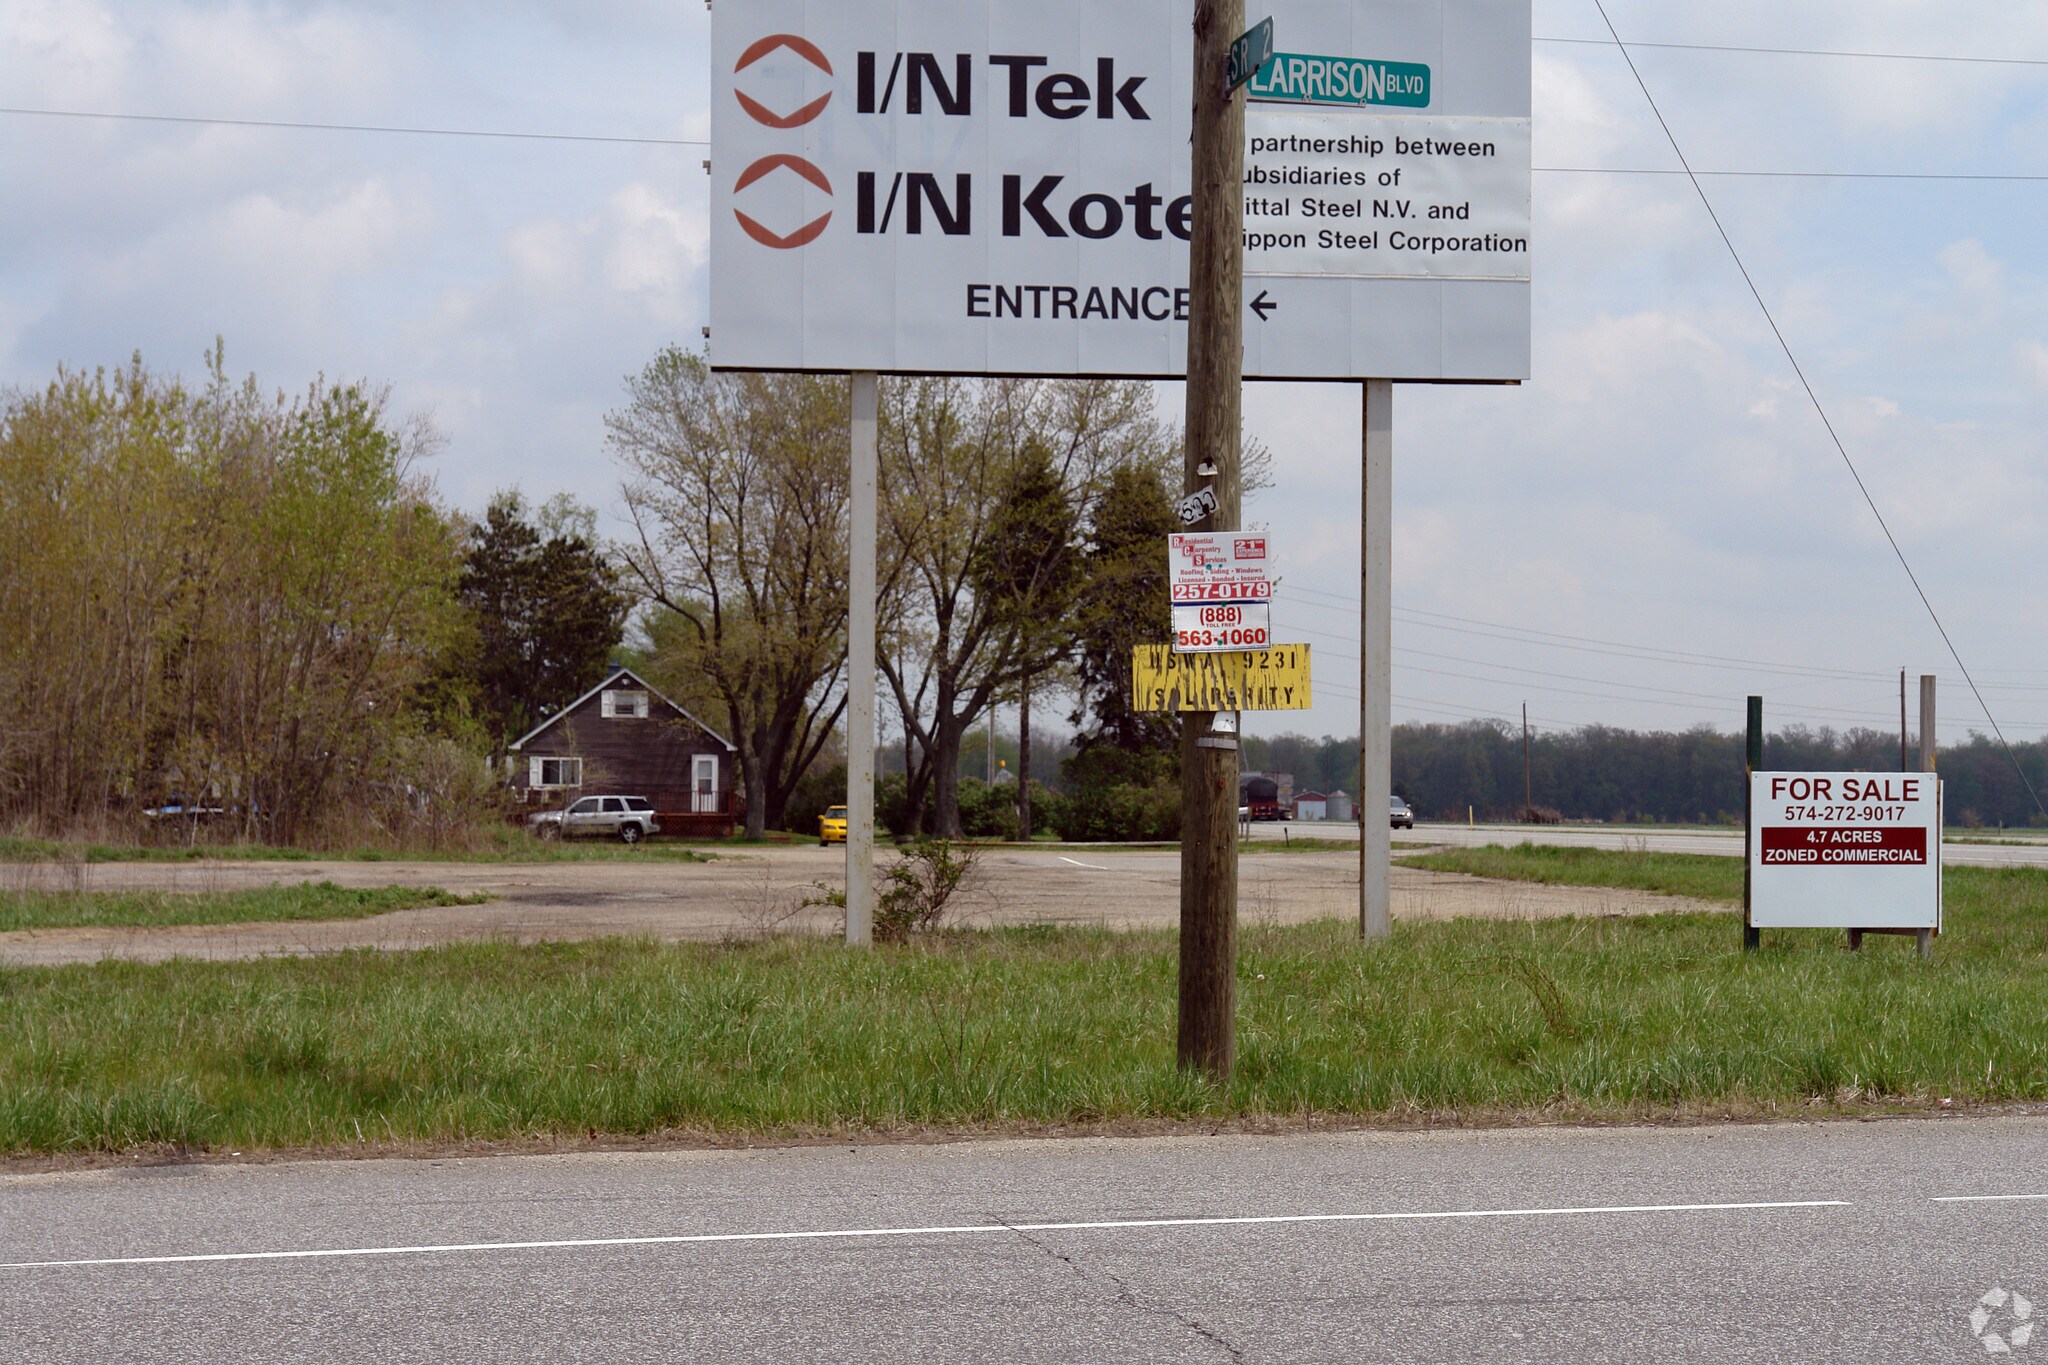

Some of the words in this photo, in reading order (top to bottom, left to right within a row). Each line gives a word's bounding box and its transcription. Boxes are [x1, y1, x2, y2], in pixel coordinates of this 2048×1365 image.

[1231, 37, 1248, 81] SR
[1262, 22, 1271, 61] 2
[857, 51, 971, 116] I/N
[989, 55, 1151, 120] Tek
[1251, 57, 1385, 100] LARRISON
[1386, 74, 1424, 95] BLVD
[1251, 135, 1384, 158] partnership
[1395, 136, 1496, 157] between
[1243, 165, 1366, 186] ubsidiaries
[1377, 168, 1402, 187] of
[857, 171, 971, 236] I/N
[1245, 197, 1290, 217] ittal
[1301, 198, 1362, 218] Steel
[1372, 200, 1417, 219] N.V.
[1427, 202, 1470, 221] and
[1242, 228, 1307, 252] ippon
[1317, 229, 1379, 250] Steel
[1389, 231, 1528, 254] Corporation
[967, 284, 1190, 321] ENTRANCE
[1172, 537, 1214, 548] Residential
[1184, 546, 1222, 556] Carpentry
[1235, 540, 1256, 549] 21
[1196, 555, 1227, 565] Services
[1175, 582, 1269, 599] 257-0179
[1199, 606, 1242, 626] (888)
[1178, 628, 1266, 646] 563-1060
[1771, 777, 1833, 801] FOR
[1842, 778, 1920, 802] SALE
[1784, 805, 1906, 821] 574-272-9017
[1806, 830, 1828, 843] 4.7
[1830, 830, 1883, 843] ACRES
[1765, 849, 1818, 862] ZONED
[1822, 849, 1923, 862] COMMERCIAL
